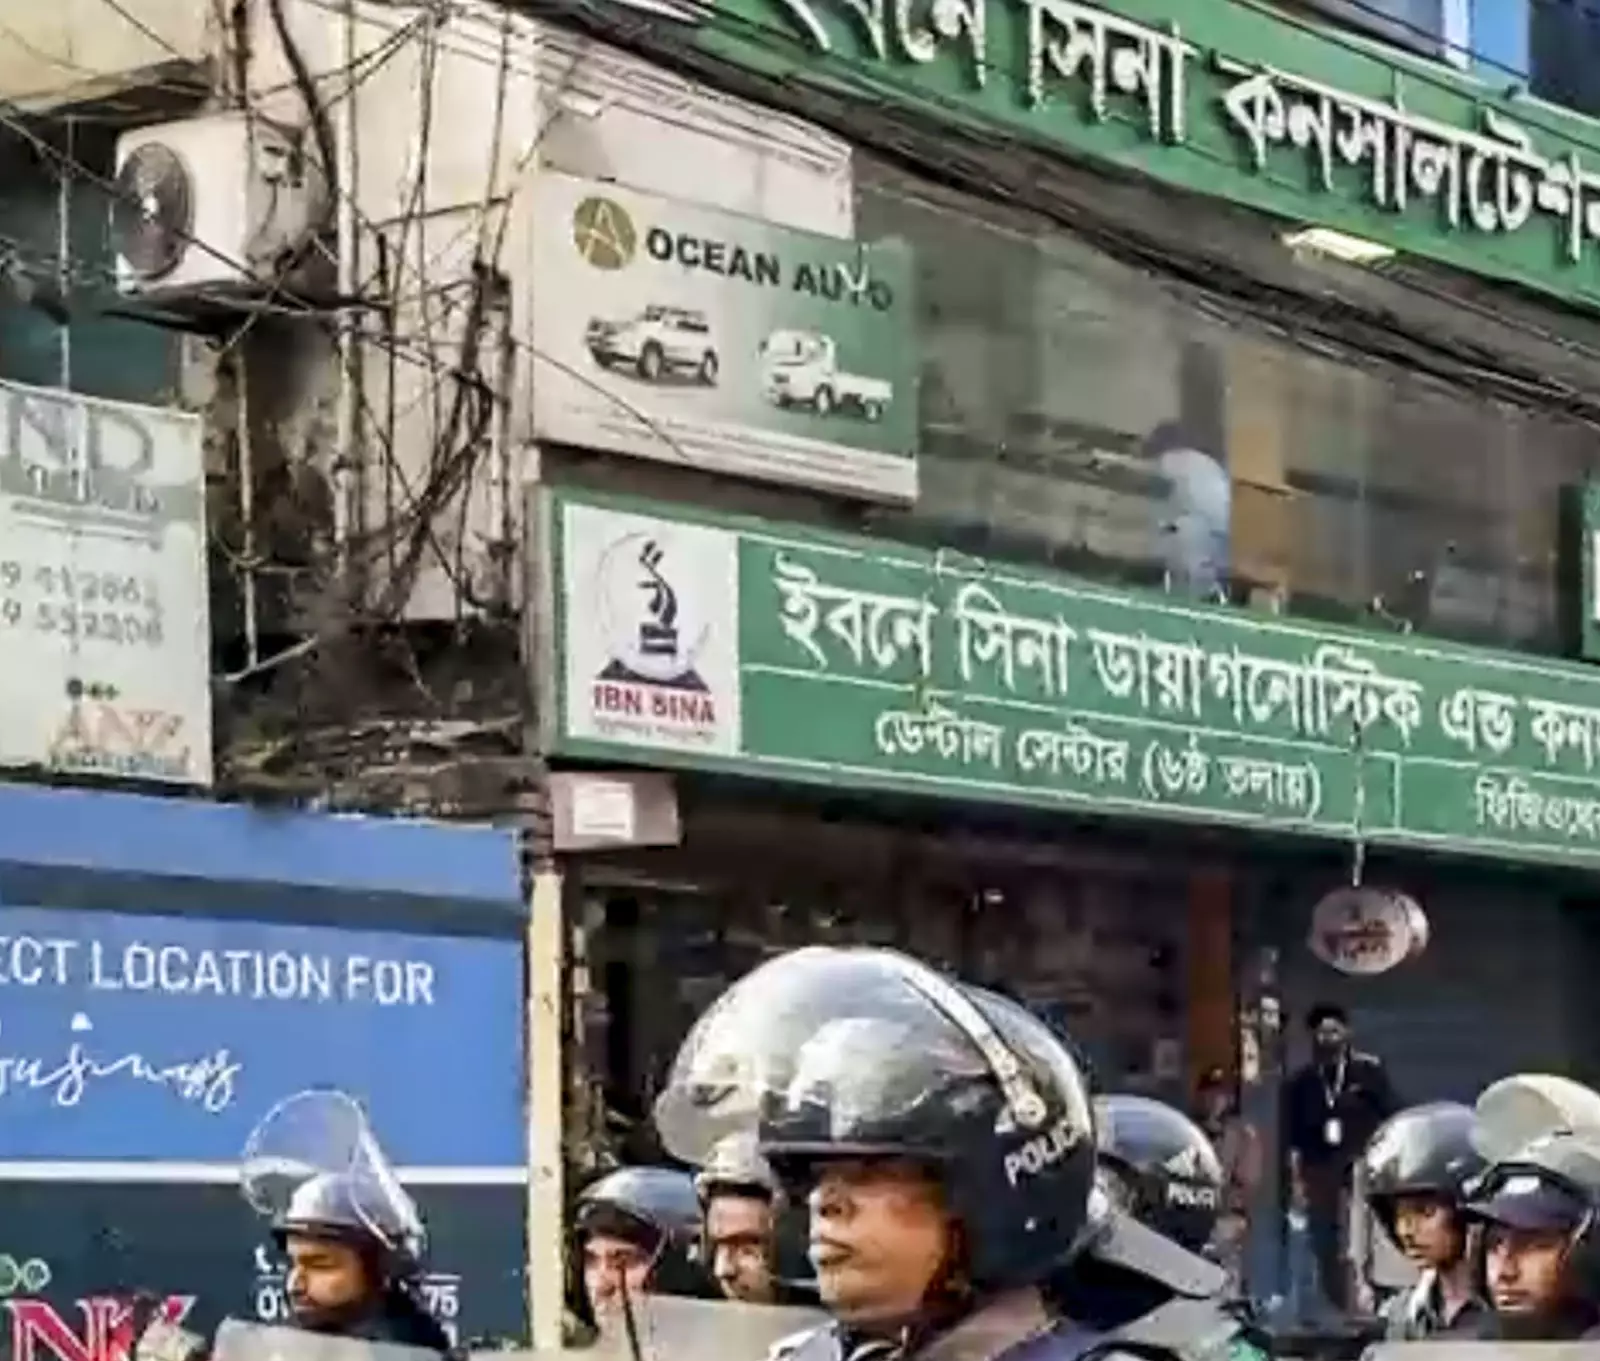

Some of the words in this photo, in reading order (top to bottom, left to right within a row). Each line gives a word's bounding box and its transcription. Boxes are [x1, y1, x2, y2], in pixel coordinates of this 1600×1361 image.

[646, 226, 780, 287] OCEAN
[774, 550, 940, 680] ইবনে
[953, 576, 1075, 695] সিনা
[594, 683, 642, 715] IBN
[651, 691, 717, 723] SINA
[1017, 716, 1127, 785] সেন্টার
[90, 941, 332, 1000] LOCATION
[346, 957, 436, 1005] FOR
